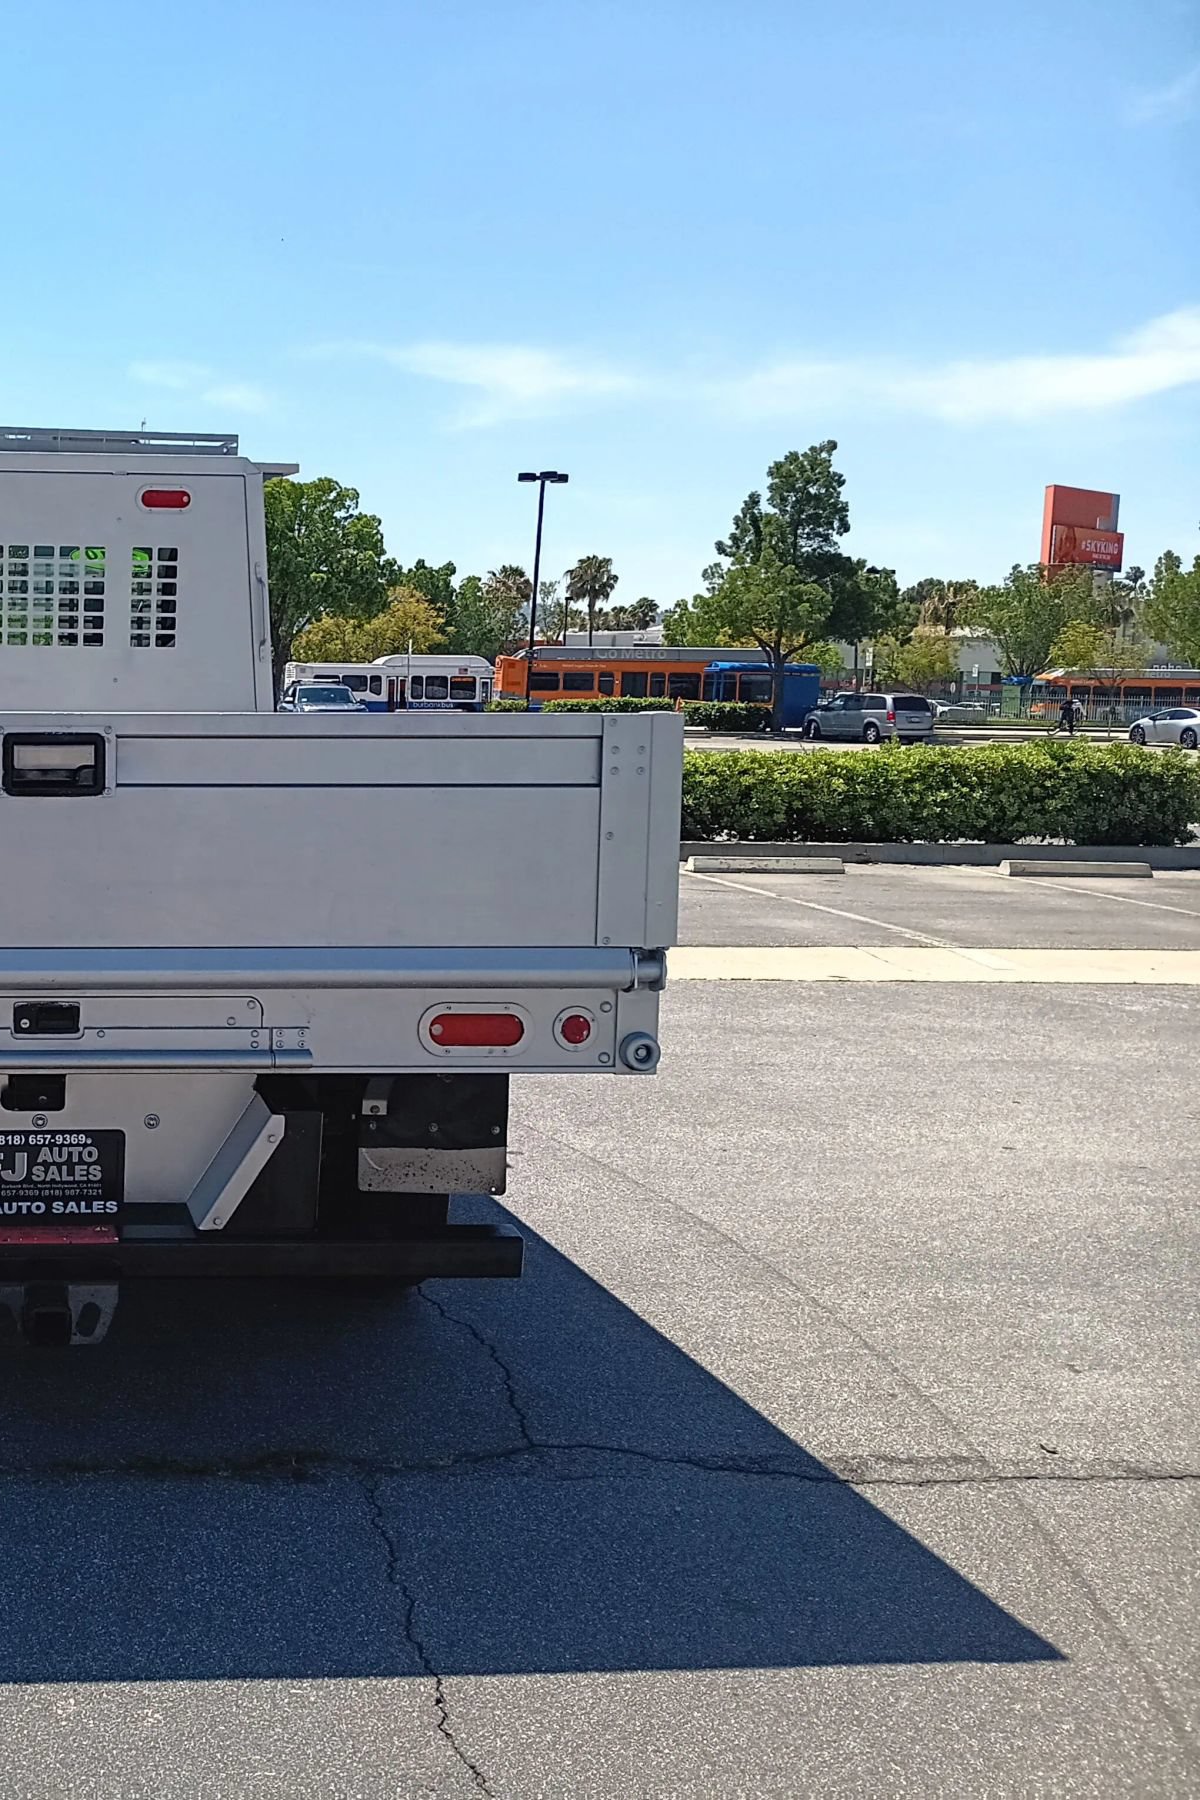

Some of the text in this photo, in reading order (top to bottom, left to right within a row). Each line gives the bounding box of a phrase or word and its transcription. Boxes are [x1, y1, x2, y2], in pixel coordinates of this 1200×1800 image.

[1081, 540, 1119, 554] #SKYKING
[621, 649, 667, 659] Metro
[29, 1134, 86, 1144] 657-9369
[37, 1146, 99, 1163] AUTO
[31, 1165, 102, 1181] SALES
[41, 1189, 63, 1197] (818)
[52, 1201, 118, 1213] SALES
